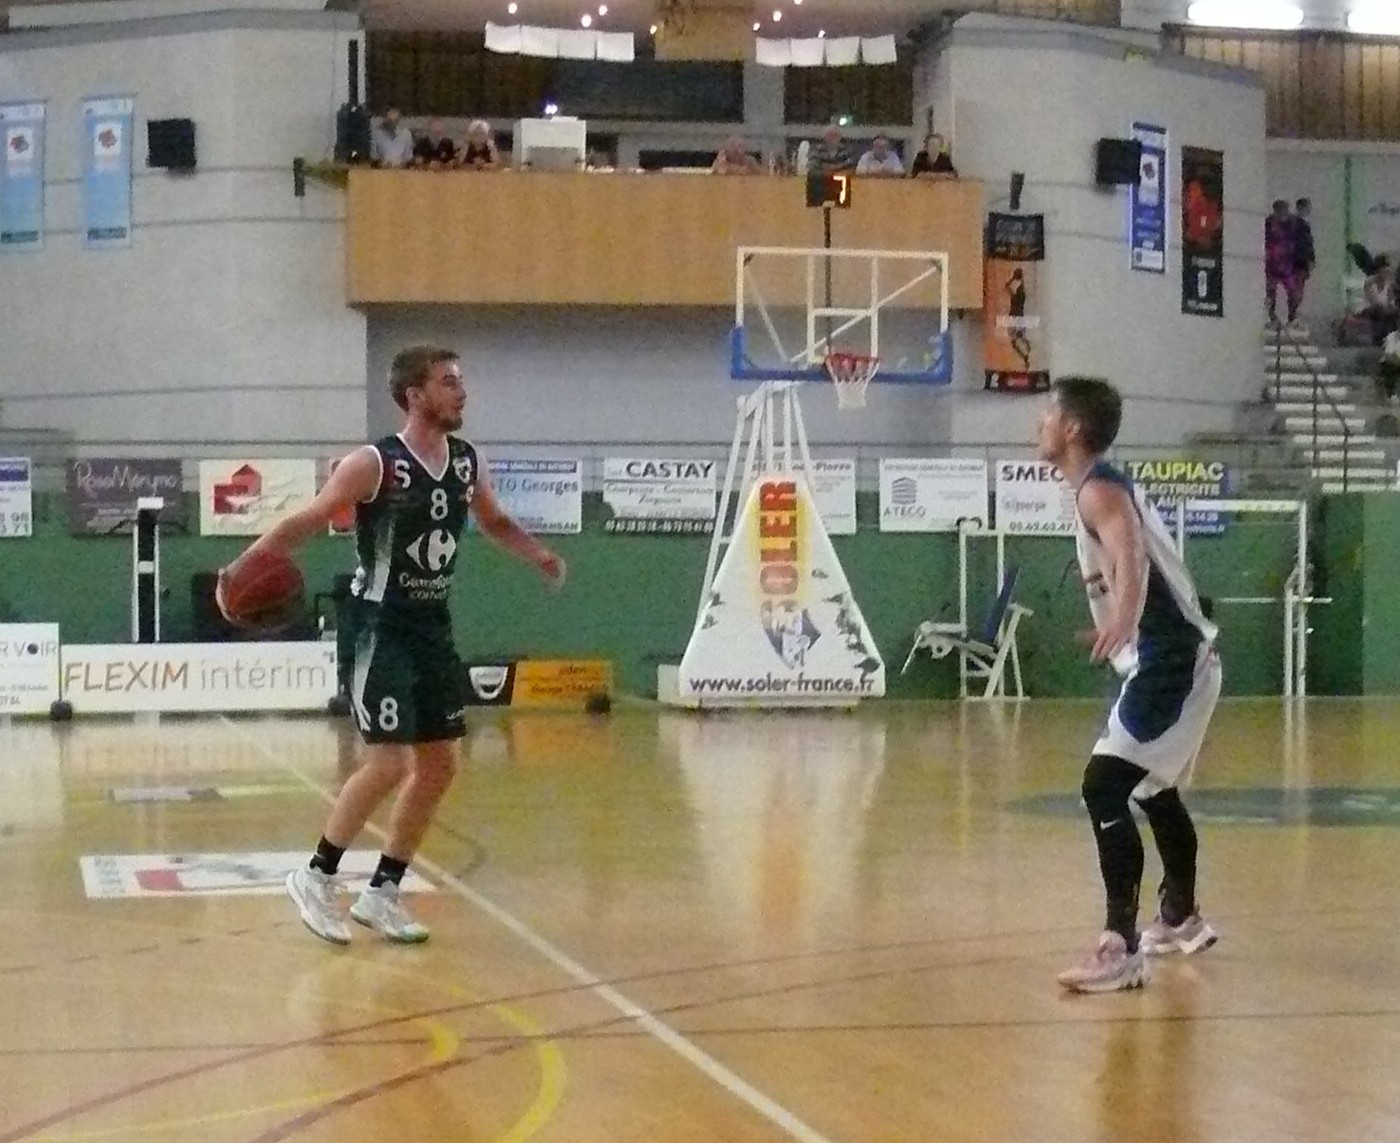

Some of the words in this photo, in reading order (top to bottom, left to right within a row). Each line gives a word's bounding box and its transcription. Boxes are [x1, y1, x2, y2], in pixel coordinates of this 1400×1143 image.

[833, 174, 847, 205] 7
[626, 461, 714, 478] CASTAY
[1127, 461, 1225, 481] TAUPIAC
[521, 479, 578, 496] Georges
[430, 488, 448, 521] 8
[759, 481, 798, 632] SOLER
[64, 661, 190, 694] FLEXIM
[200, 658, 327, 691] intérim
[689, 671, 875, 694] www.soler-france.fr
[378, 696, 399, 732] 8
